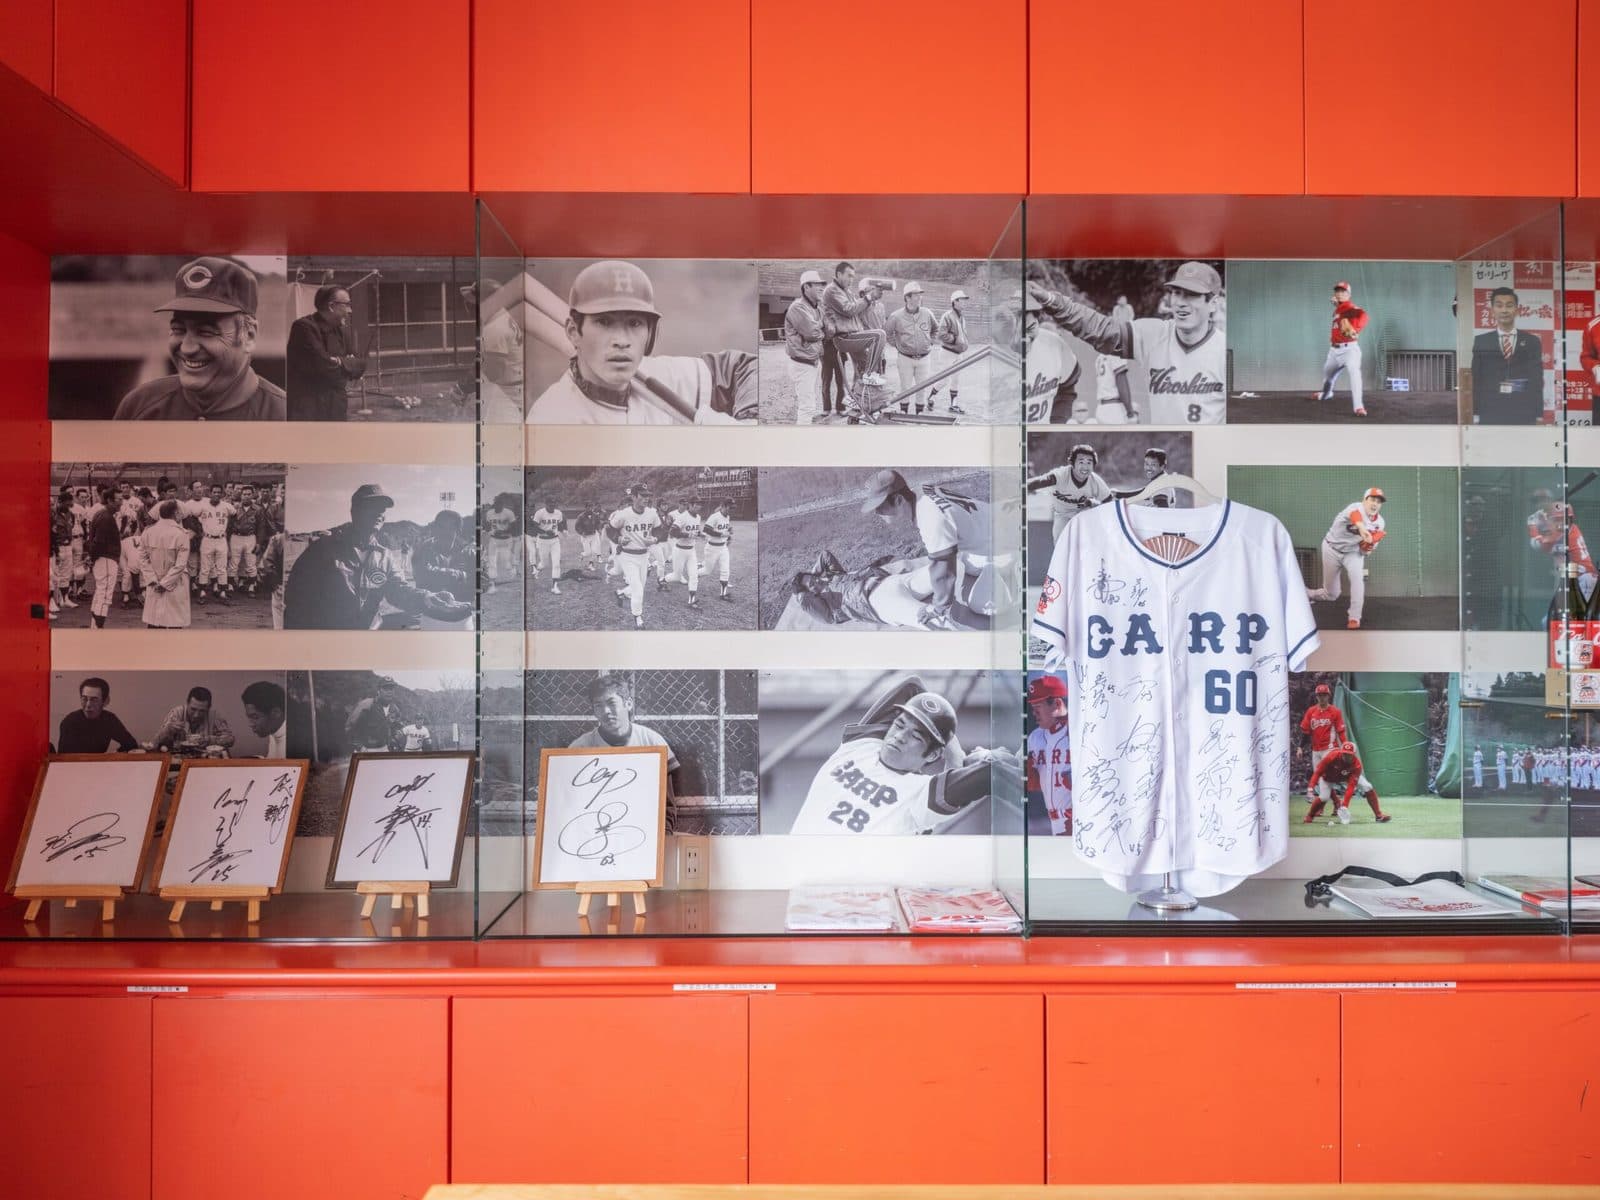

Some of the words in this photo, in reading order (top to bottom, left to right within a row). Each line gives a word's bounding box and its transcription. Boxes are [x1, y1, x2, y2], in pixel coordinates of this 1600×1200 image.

[183, 265, 213, 289] C
[613, 270, 635, 293] H
[1150, 367, 1224, 395] Hiroshima
[1027, 400, 1049, 423] 20
[1188, 403, 1201, 423] 8
[1087, 611, 1270, 660] CARP
[1204, 669, 1258, 716] 60
[827, 800, 870, 833] 28
